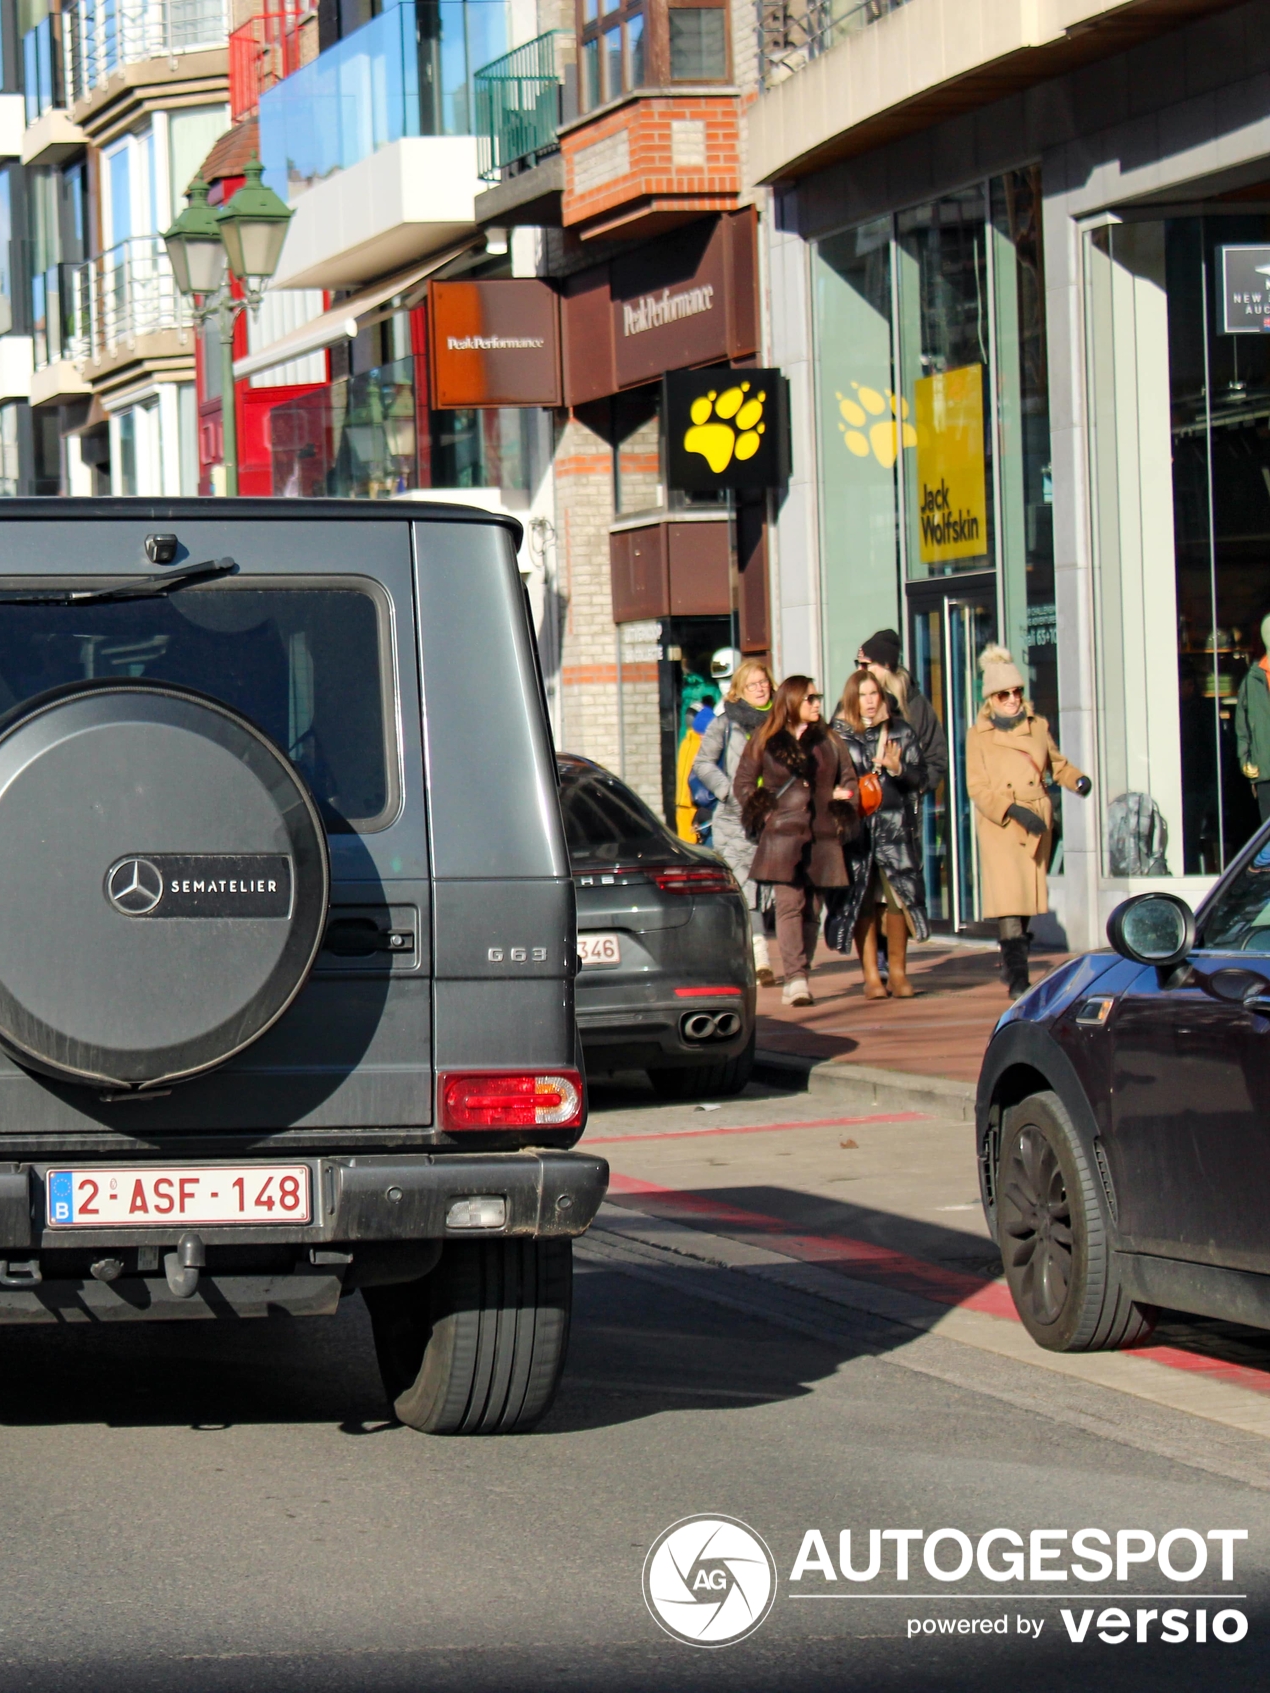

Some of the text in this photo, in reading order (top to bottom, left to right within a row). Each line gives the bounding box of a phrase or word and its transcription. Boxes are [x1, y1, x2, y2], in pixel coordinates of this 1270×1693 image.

[1233, 292, 1262, 303] NEW
[623, 284, 713, 337] PeakPerformance
[447, 336, 544, 350] PeakPerformance
[920, 478, 949, 515] Jack
[920, 509, 980, 547] Wolfskin
[171, 880, 277, 893] SEMATELIER
[55, 1202, 69, 1219] B
